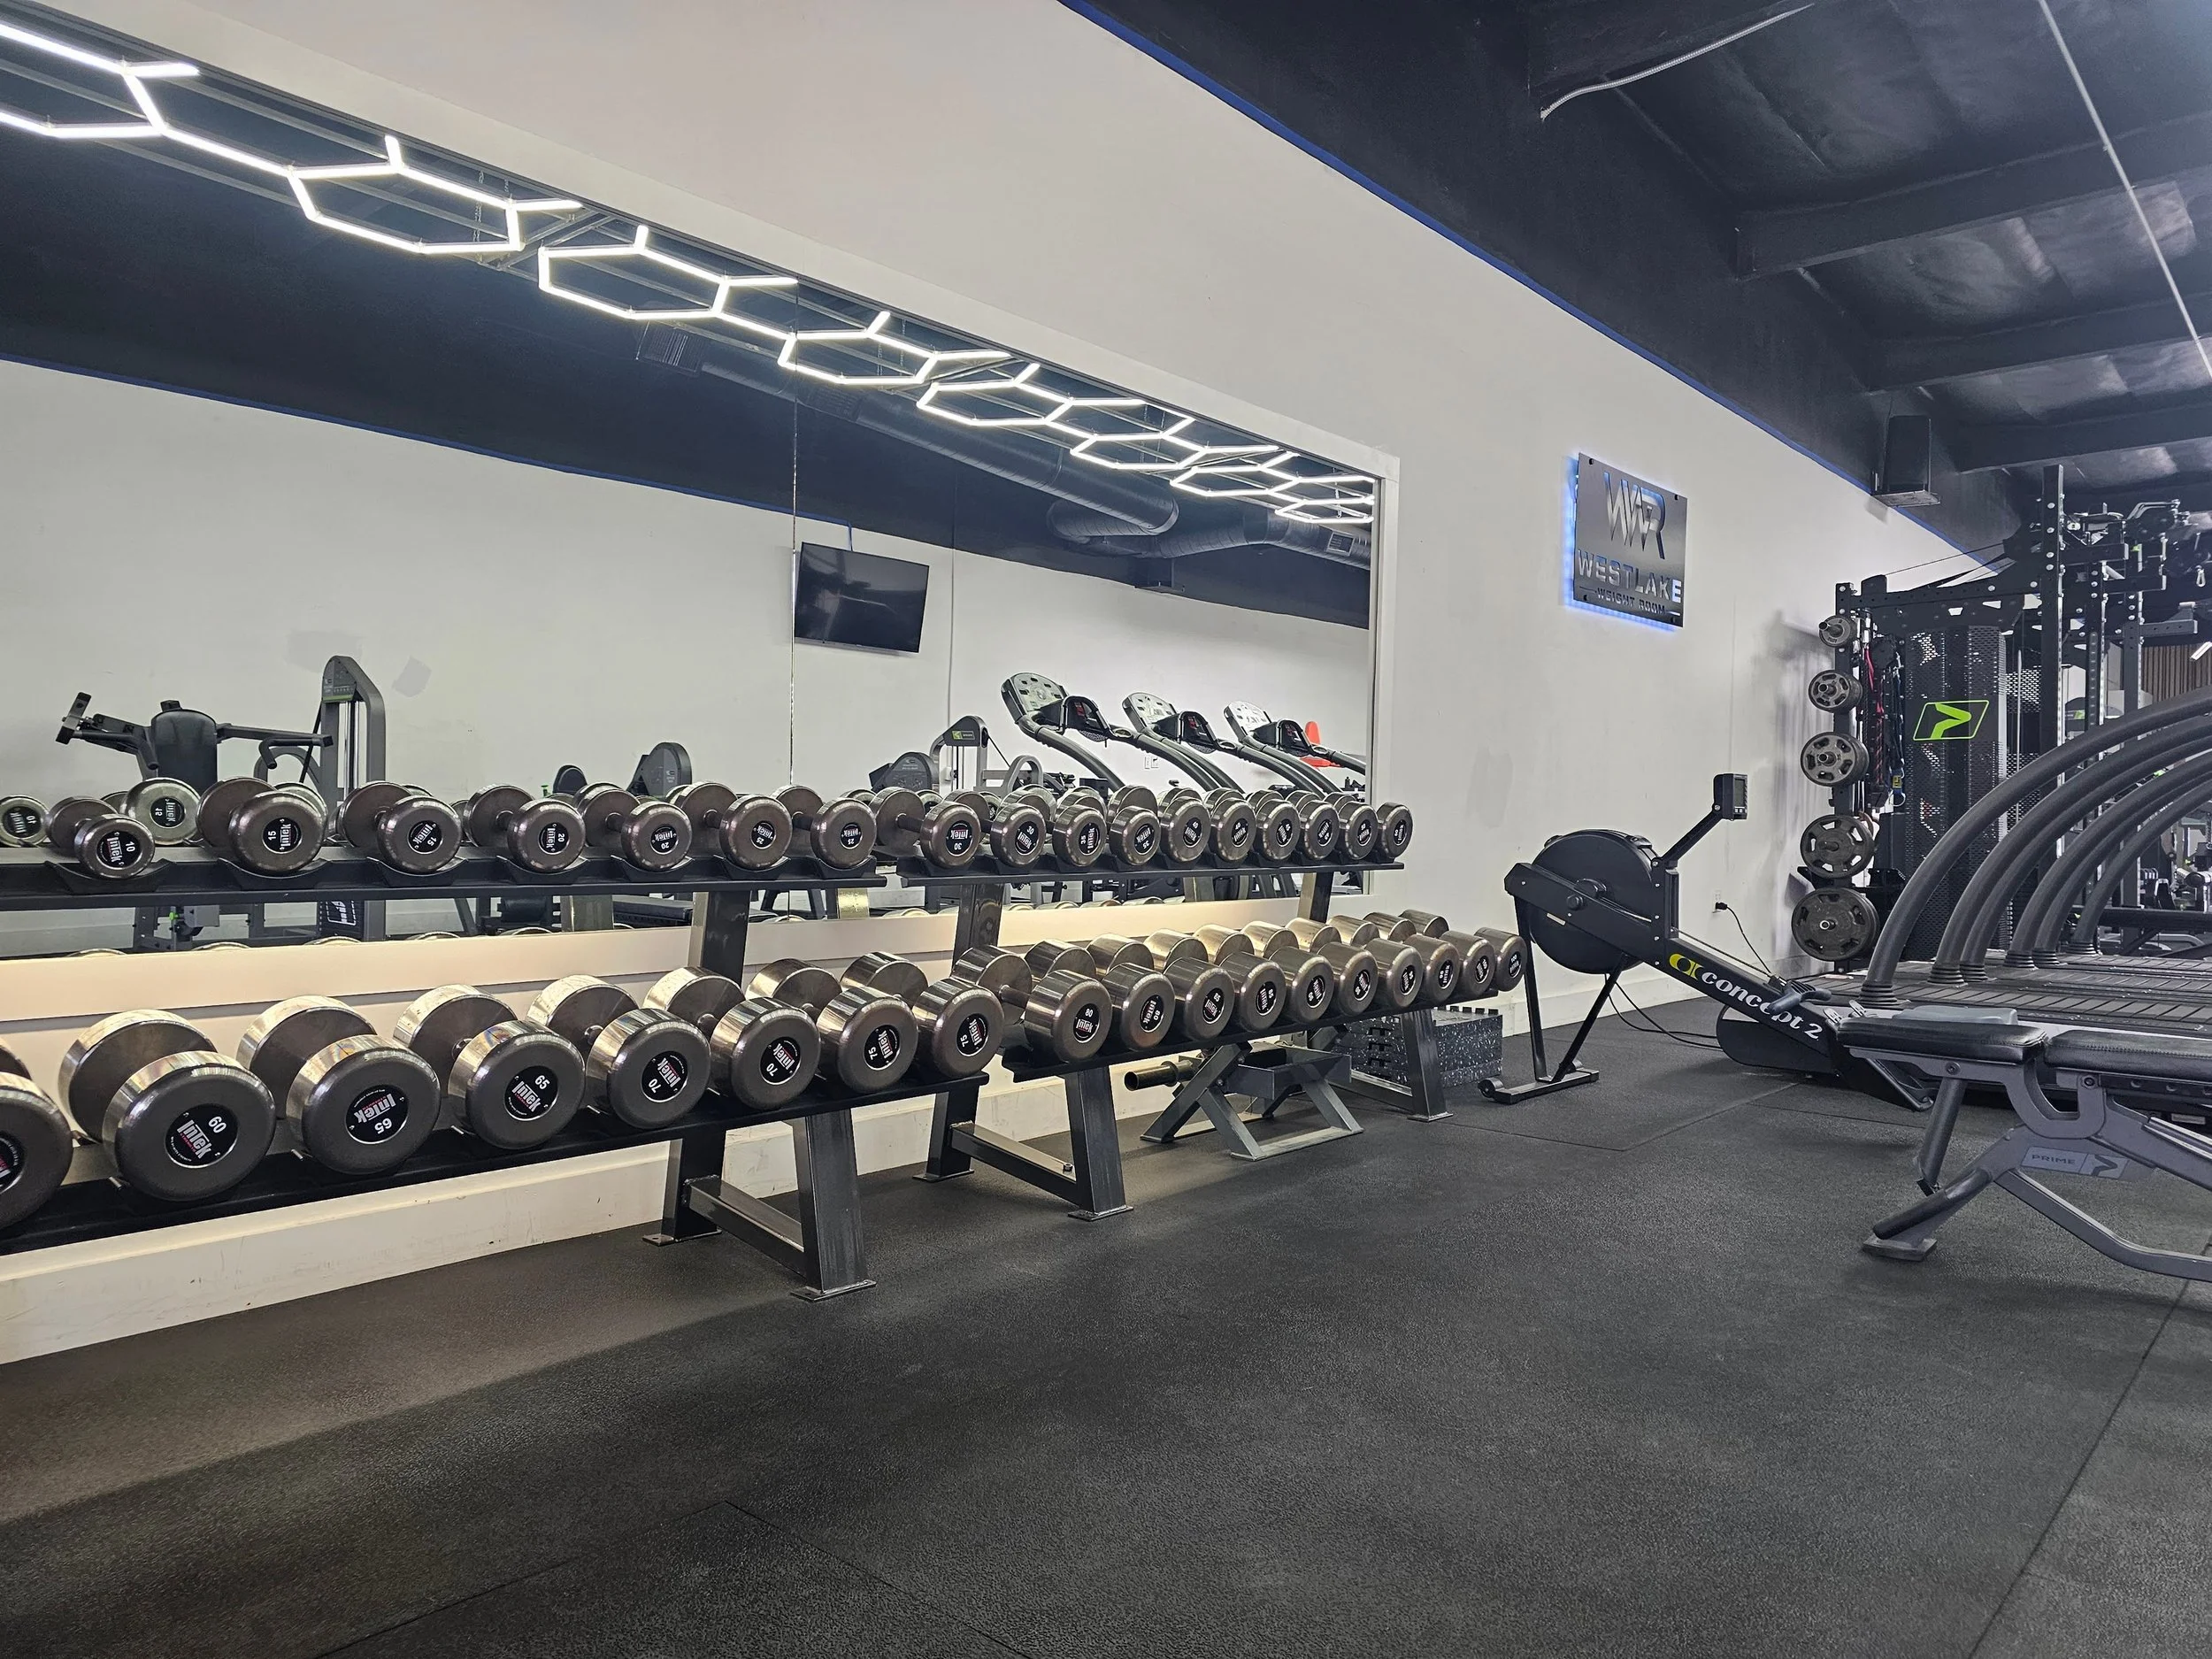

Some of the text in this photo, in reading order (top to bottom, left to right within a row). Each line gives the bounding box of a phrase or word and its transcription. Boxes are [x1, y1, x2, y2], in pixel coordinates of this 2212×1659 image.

[1578, 549, 1682, 603] WESTLAKE
[1596, 588, 1665, 615] WEIGHT ROOM
[267, 830, 277, 841] 15
[280, 824, 291, 847] InTek
[412, 824, 434, 844] InTek
[557, 833, 565, 842] 20
[655, 830, 672, 841] InTek
[950, 829, 969, 840] InTek
[1026, 826, 1034, 835] 30
[427, 836, 437, 847] 15
[546, 828, 556, 849] InTek
[1018, 832, 1033, 849] InTek
[1080, 835, 1087, 845] 35
[1142, 841, 1150, 849] 35
[107, 837, 123, 863] InTek
[126, 841, 136, 852] 10
[1213, 993, 1221, 1002] 85
[1268, 988, 1274, 999] 85
[1085, 1009, 1094, 1018] 80
[1143, 1000, 1156, 1024] InTek
[1153, 1010, 1161, 1021] 80
[1204, 999, 1217, 1017] InTek
[969, 1018, 982, 1046] InTek
[1076, 1018, 1094, 1033] InTek
[1804, 1023, 1824, 1040] 2
[878, 1030, 894, 1059] InTek
[960, 1034, 969, 1048] 75
[772, 1043, 795, 1071] InTek
[868, 1046, 878, 1060] 75
[657, 1057, 681, 1087] InTek
[766, 1063, 778, 1077] 70
[534, 1075, 550, 1089] 65
[649, 1079, 661, 1094] 70
[511, 1080, 541, 1112] InTek
[354, 1093, 396, 1124] InTek
[208, 1116, 227, 1133] 60
[374, 1118, 392, 1134] 65
[177, 1119, 212, 1159] InTek
[2032, 1154, 2076, 1165] PRIME
